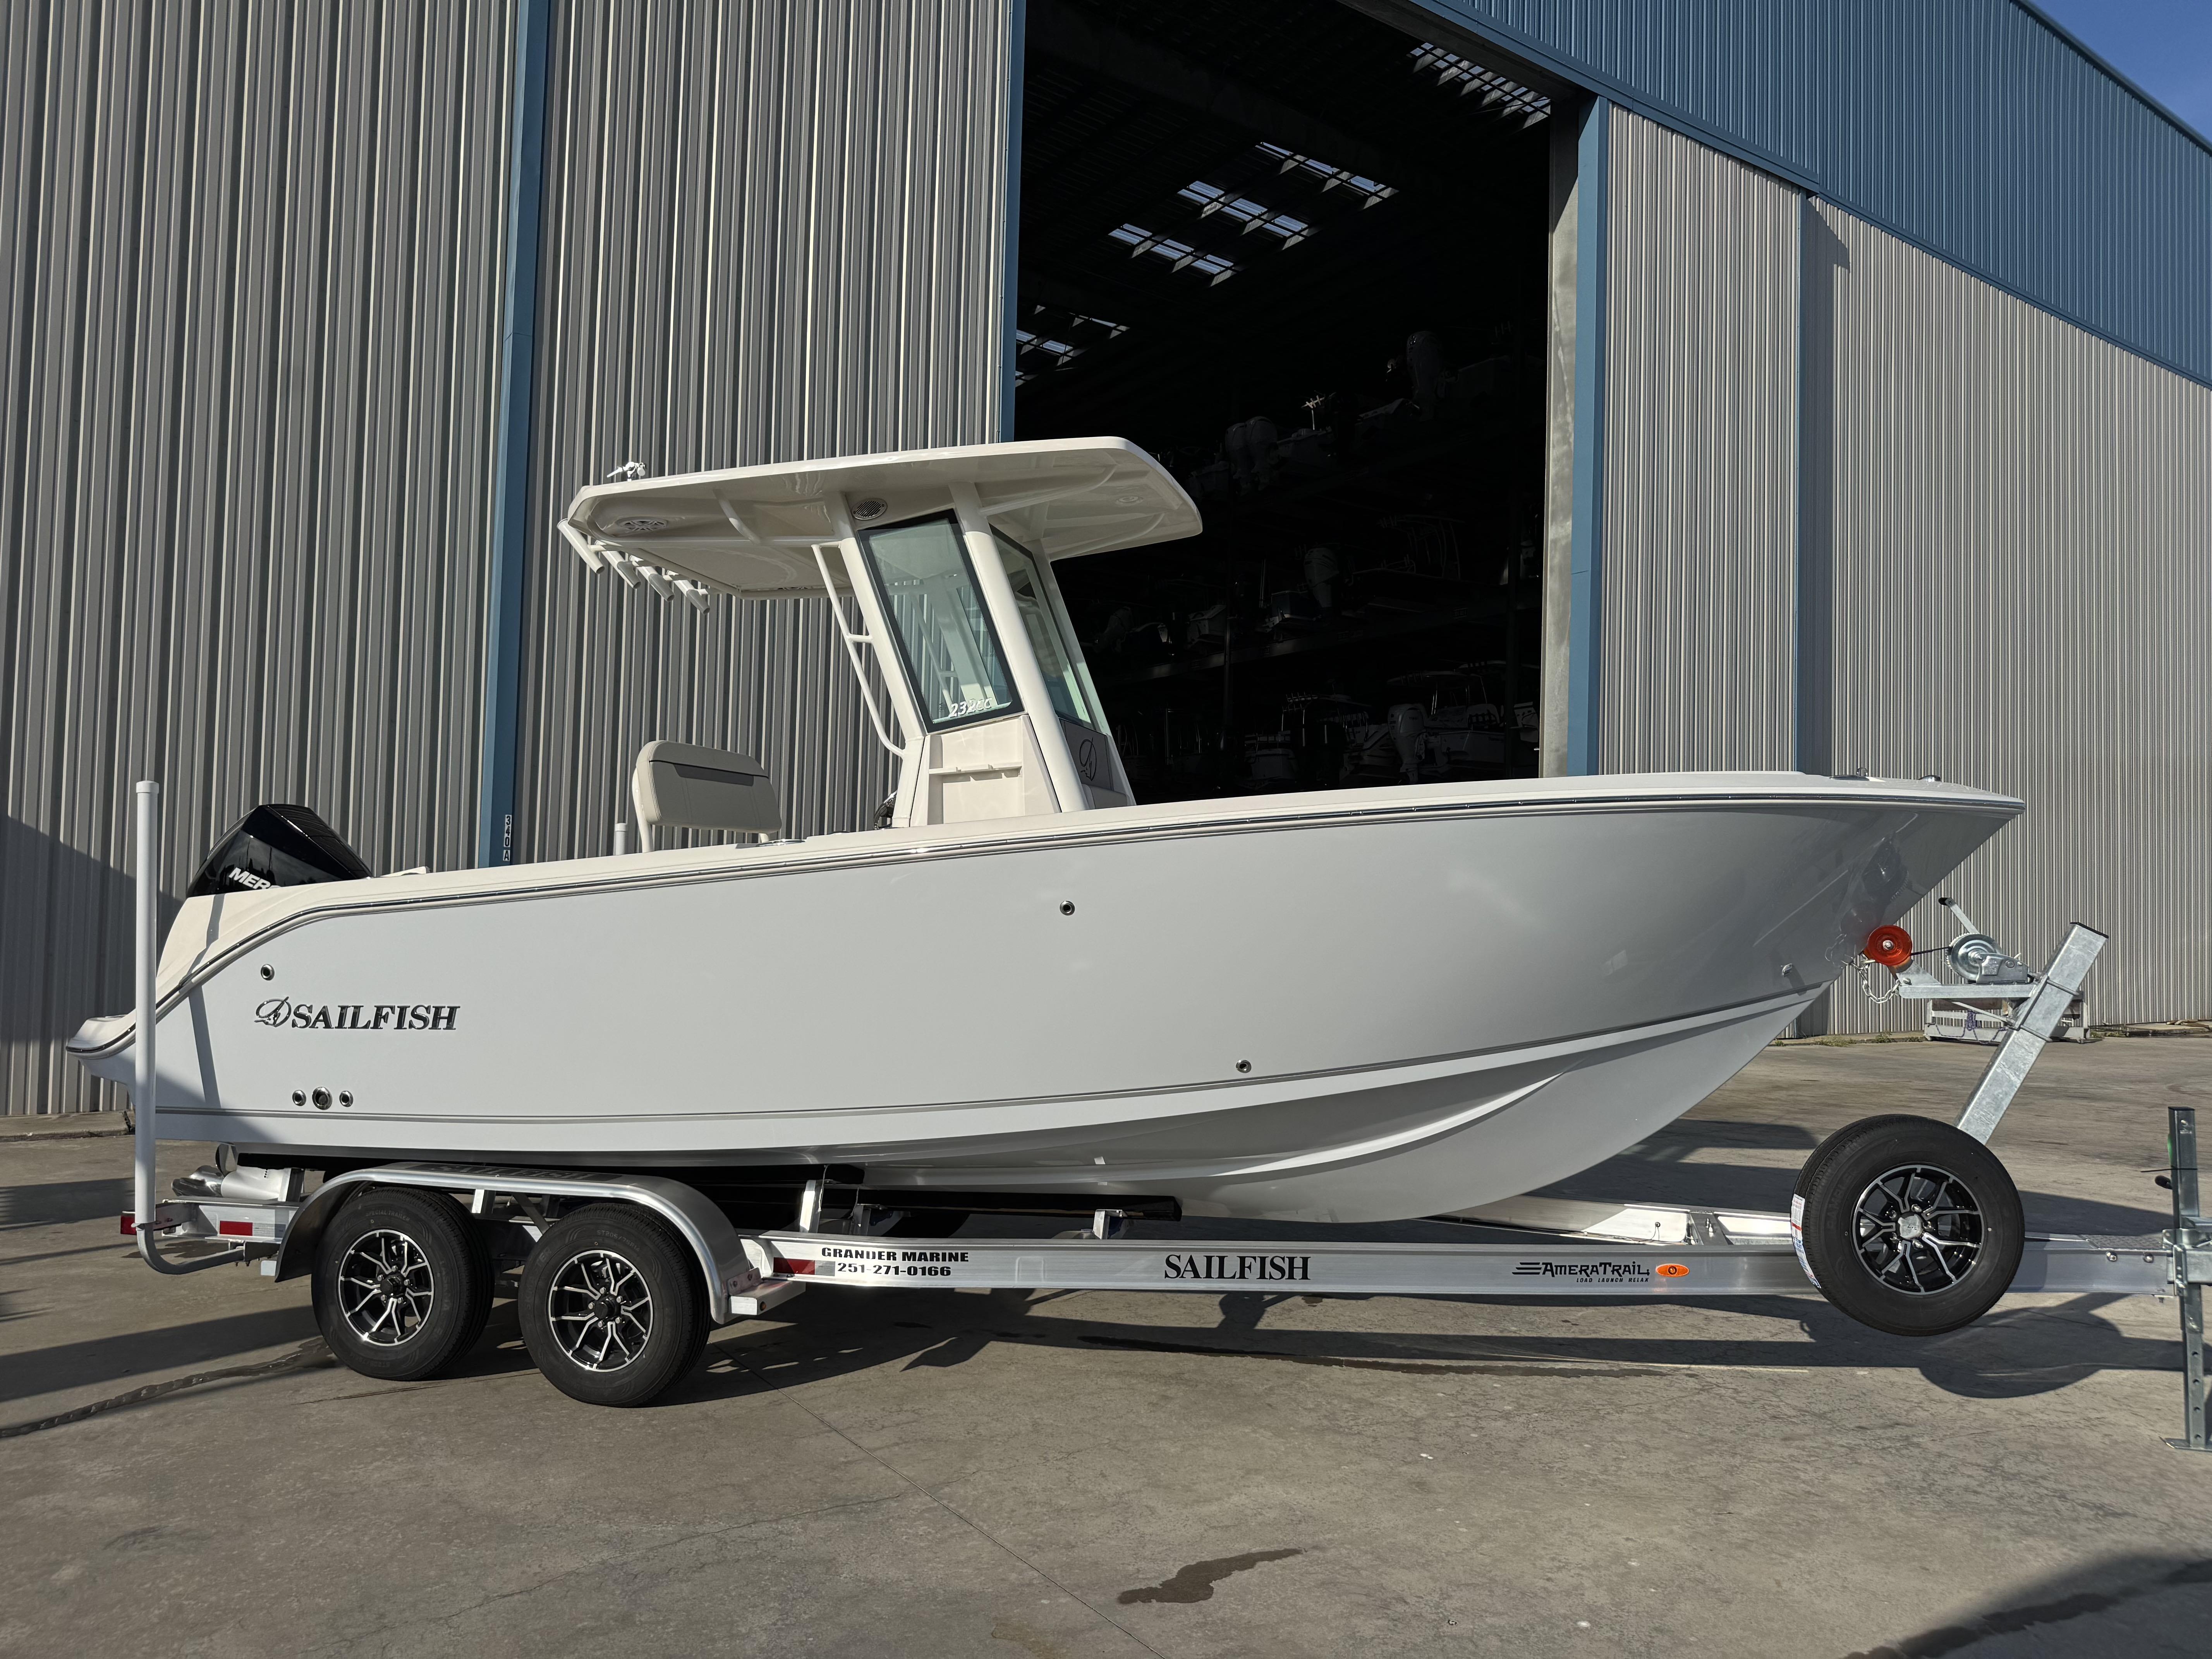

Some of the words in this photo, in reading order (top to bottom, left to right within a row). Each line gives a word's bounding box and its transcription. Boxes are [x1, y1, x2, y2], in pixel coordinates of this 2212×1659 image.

[292, 1005, 460, 1030] SAILFISH
[388, 1211, 411, 1221] TRAILER
[822, 1247, 896, 1261] GRANDER
[902, 1252, 969, 1262] MARINE
[838, 1262, 951, 1276] 251-271-0166
[1164, 1254, 1311, 1280] SAILFISH
